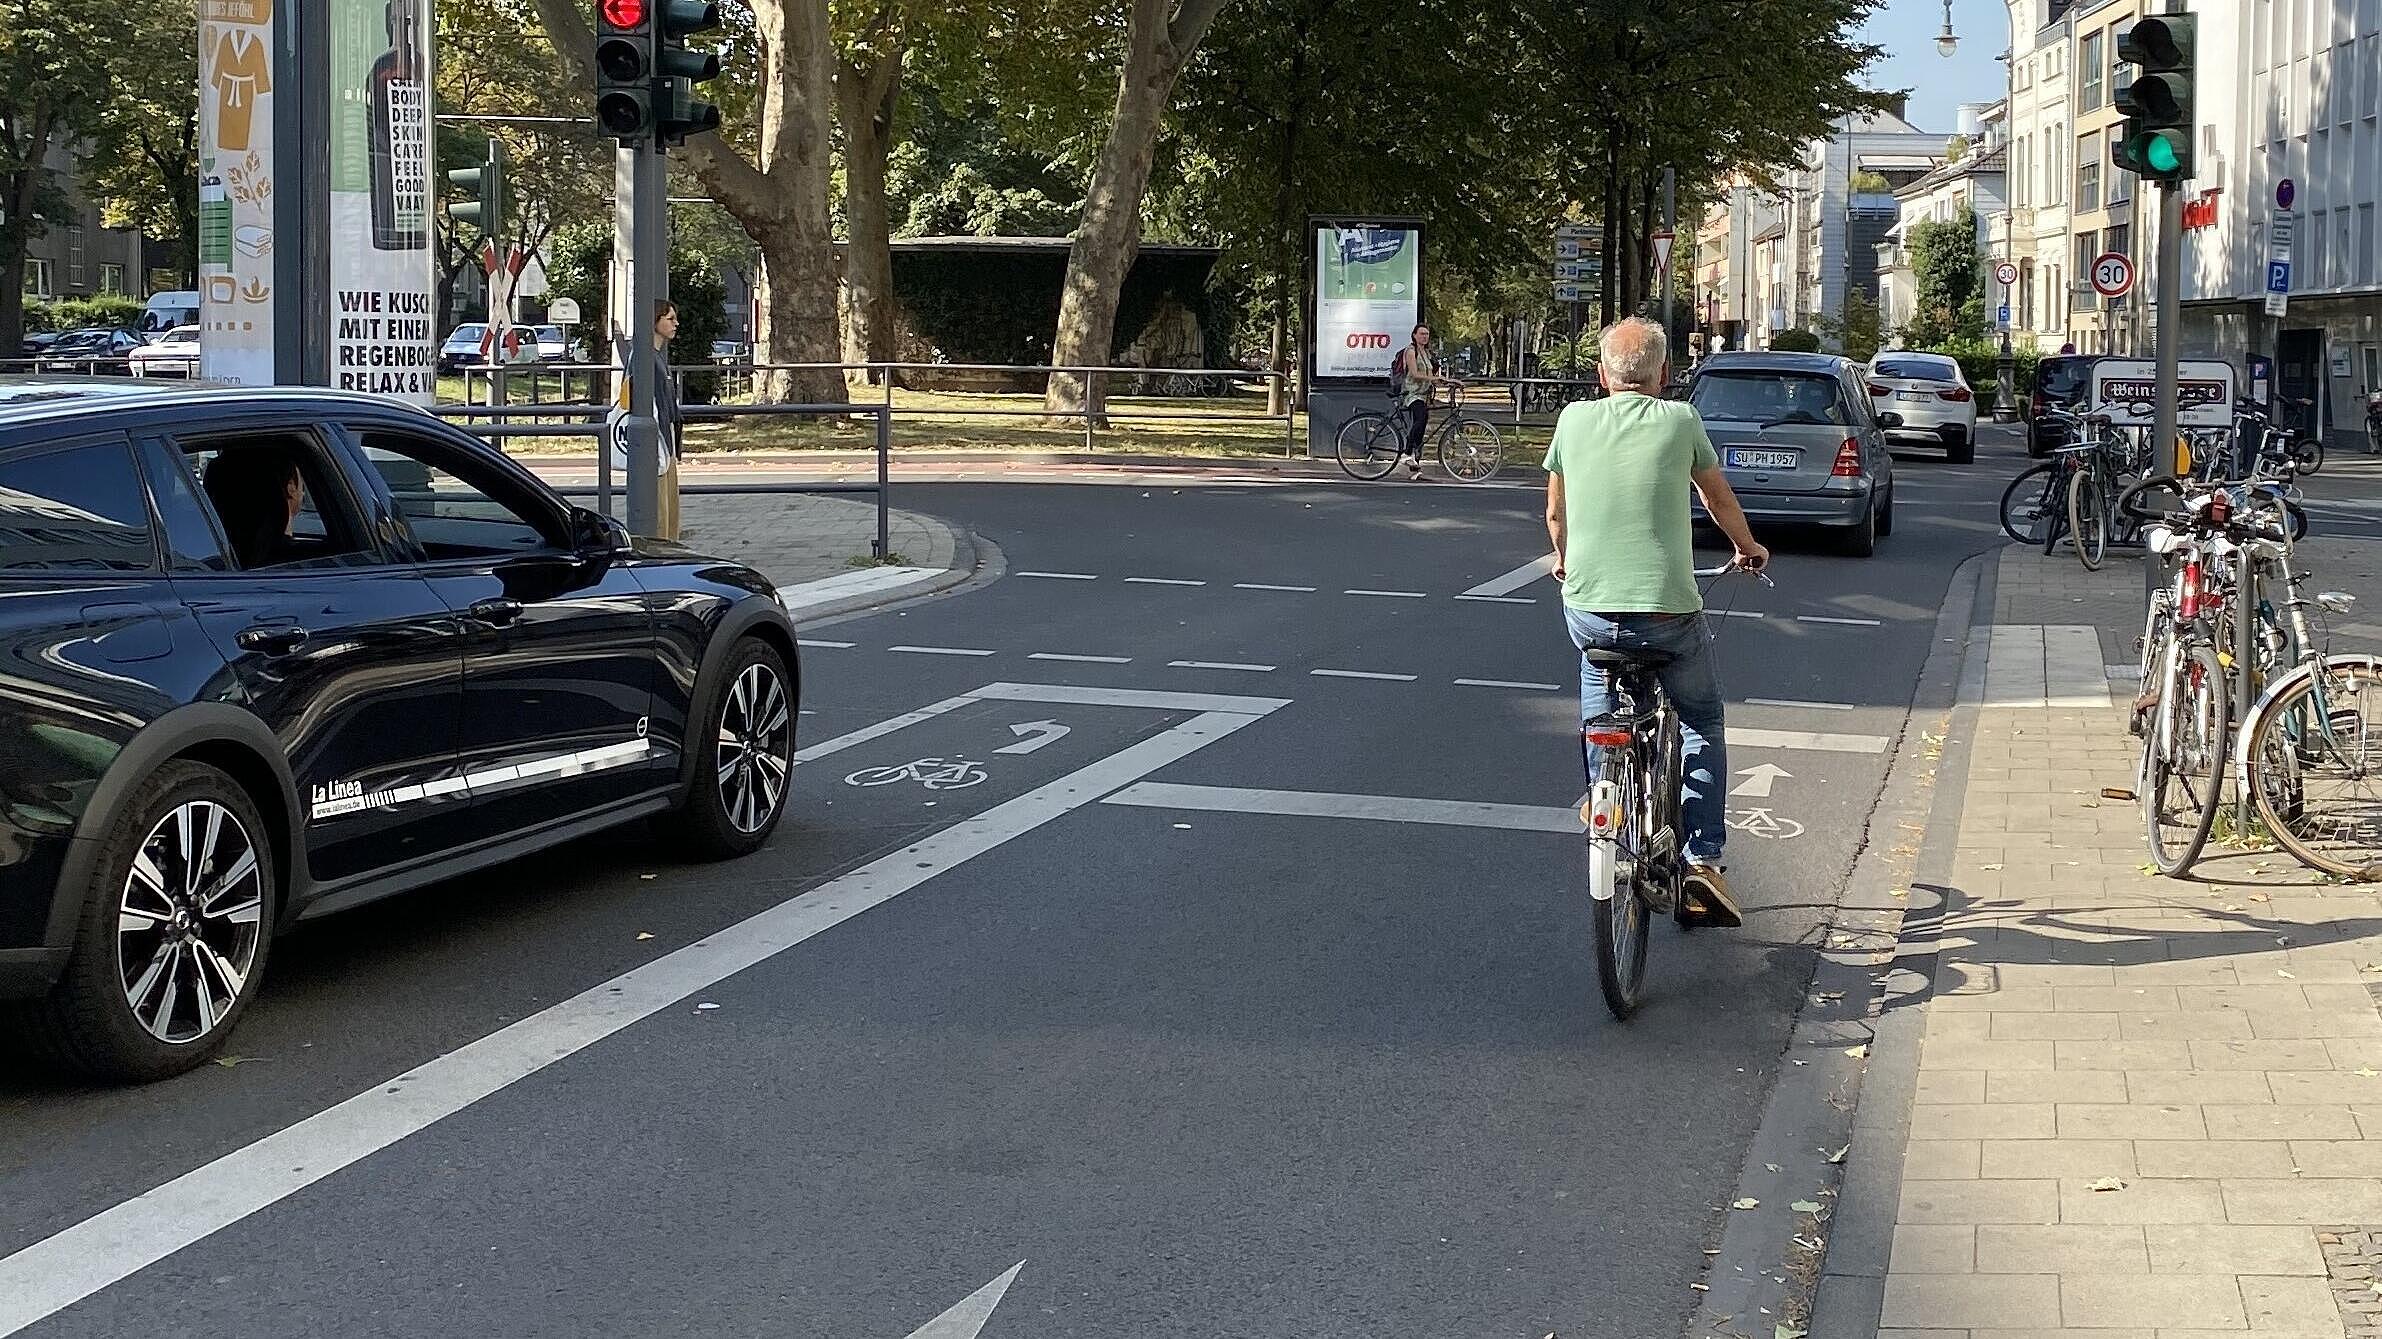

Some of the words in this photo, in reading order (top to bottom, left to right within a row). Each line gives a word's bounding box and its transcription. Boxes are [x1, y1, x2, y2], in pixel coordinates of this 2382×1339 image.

[391, 89, 422, 105] BODY
[392, 107, 423, 123] DEEP
[392, 125, 423, 141] SKIN
[393, 143, 423, 159] CARE
[394, 161, 424, 177] FEEL
[395, 178, 424, 193] GOOD
[2000, 268, 2014, 280] 30
[2099, 264, 2125, 285] 30
[338, 291, 382, 313] WIE
[338, 318, 381, 340] MIT
[1346, 333, 1391, 349] OTTO
[340, 372, 406, 394] RELAX
[408, 372, 419, 393] &
[1735, 452, 1748, 463] SU
[1755, 453, 1768, 464] PH
[1770, 453, 1795, 465] 1957
[311, 784, 326, 803] La
[328, 779, 363, 801] Linea
